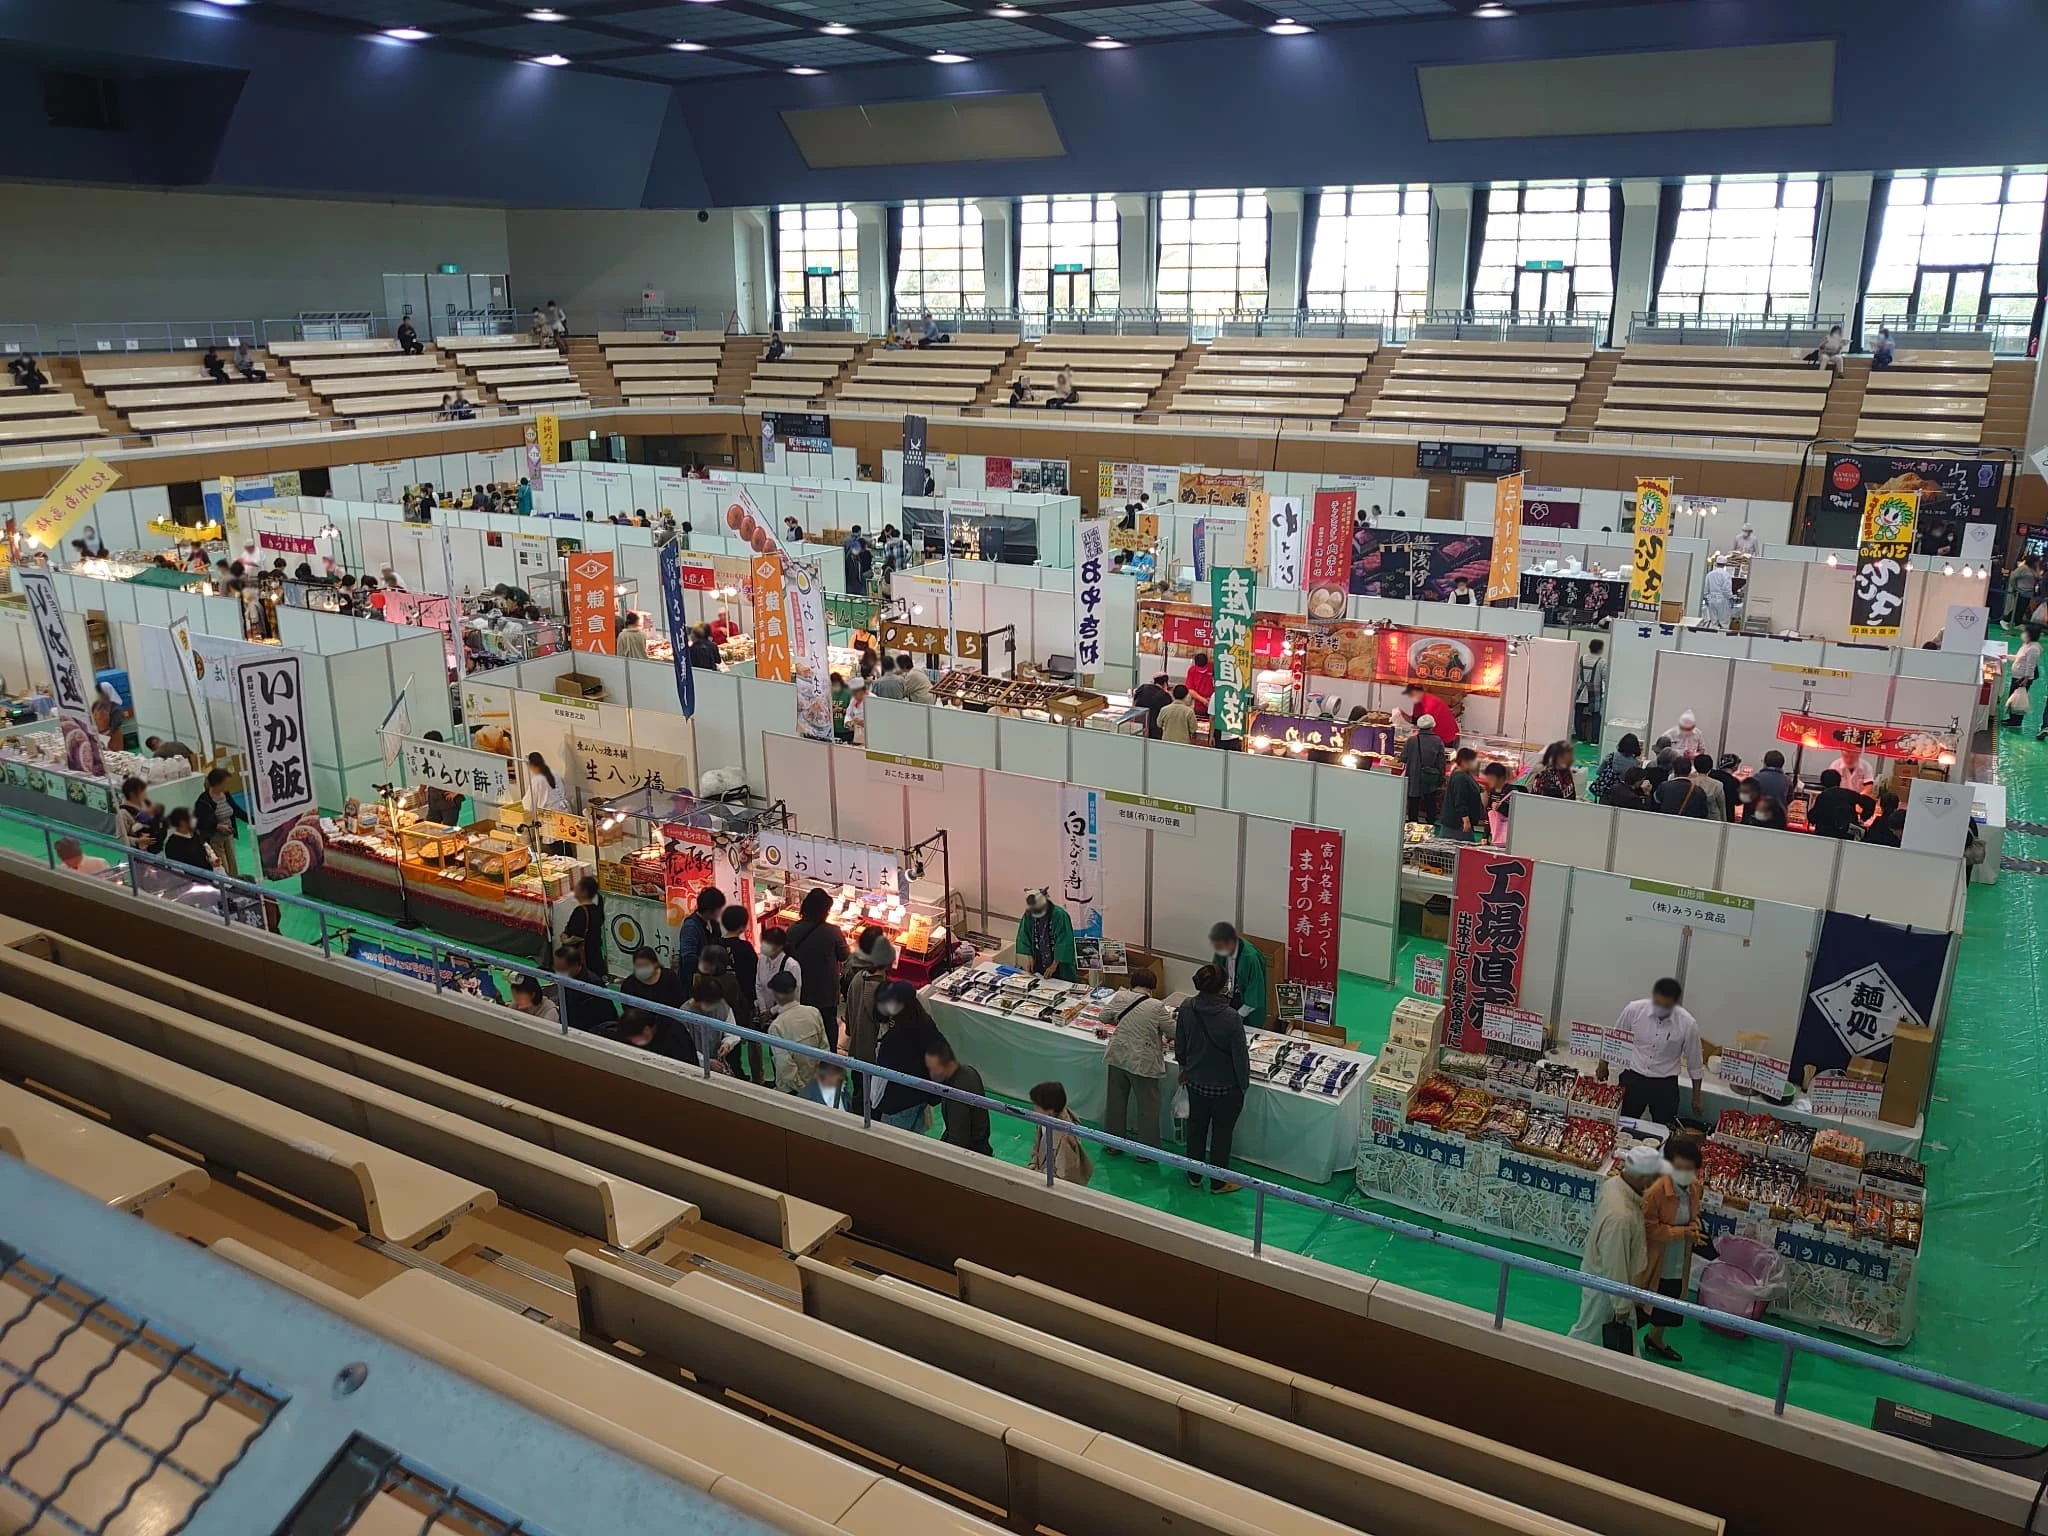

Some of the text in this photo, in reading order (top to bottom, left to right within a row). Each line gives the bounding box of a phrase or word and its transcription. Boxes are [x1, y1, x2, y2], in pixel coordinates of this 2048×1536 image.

[258, 668, 305, 803] いか飯
[421, 756, 492, 794] わらび餅
[585, 758, 665, 794] 生八ツ橋
[1173, 803, 1193, 813] 4-11
[1924, 796, 1952, 807] 三丁目
[794, 850, 890, 888] おこたま
[1294, 848, 1315, 957] ますの寿し
[1317, 841, 1337, 970] 富山名産 手づくり
[1651, 900, 1726, 924] (株)みうら食品
[1677, 887, 1750, 909] 山形県 4-12
[1375, 1134, 1463, 1166] みうら食品
[1500, 1165, 1593, 1200] みうら食品
[1775, 1239, 1890, 1279] みうら食品
